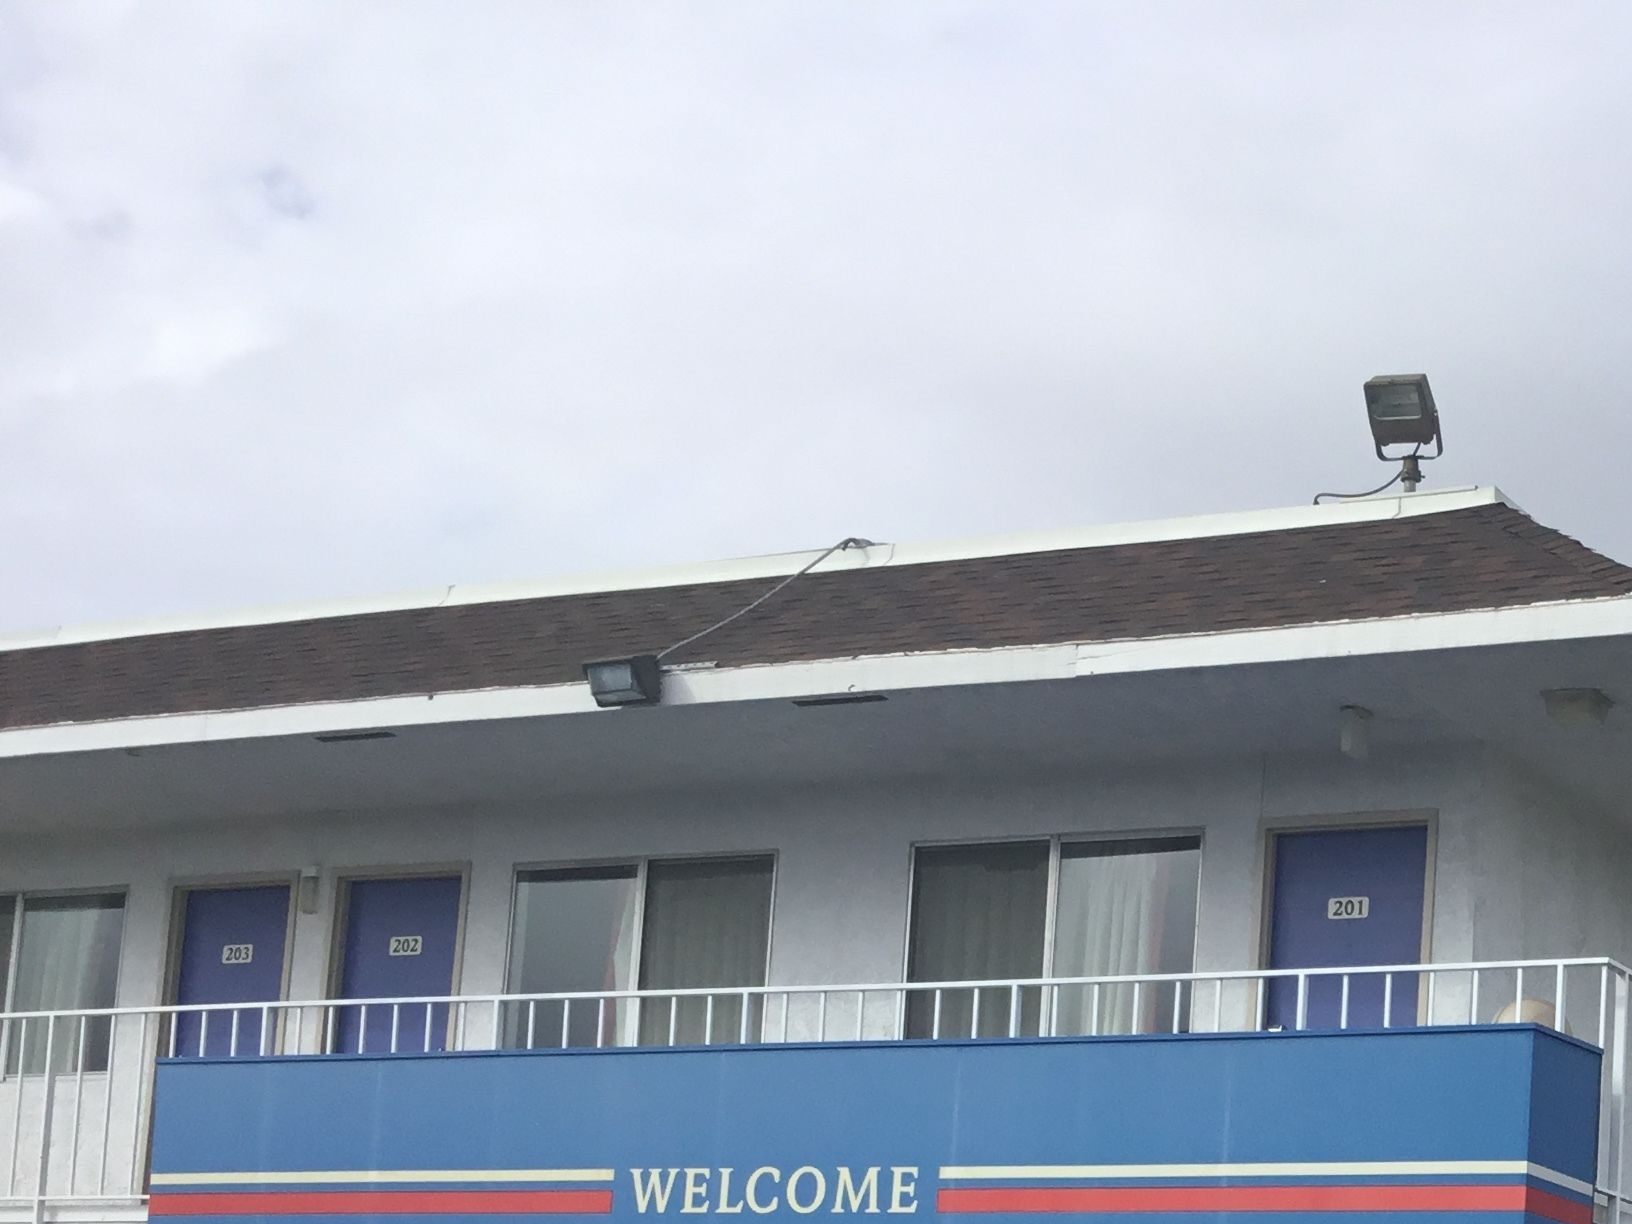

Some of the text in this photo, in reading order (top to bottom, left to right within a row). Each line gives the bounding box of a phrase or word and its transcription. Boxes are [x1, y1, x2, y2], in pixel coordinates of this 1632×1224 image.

[1333, 899, 1363, 916] 201
[226, 946, 250, 961] 203
[393, 938, 418, 953] 202
[630, 1165, 919, 1214] WELCOME
